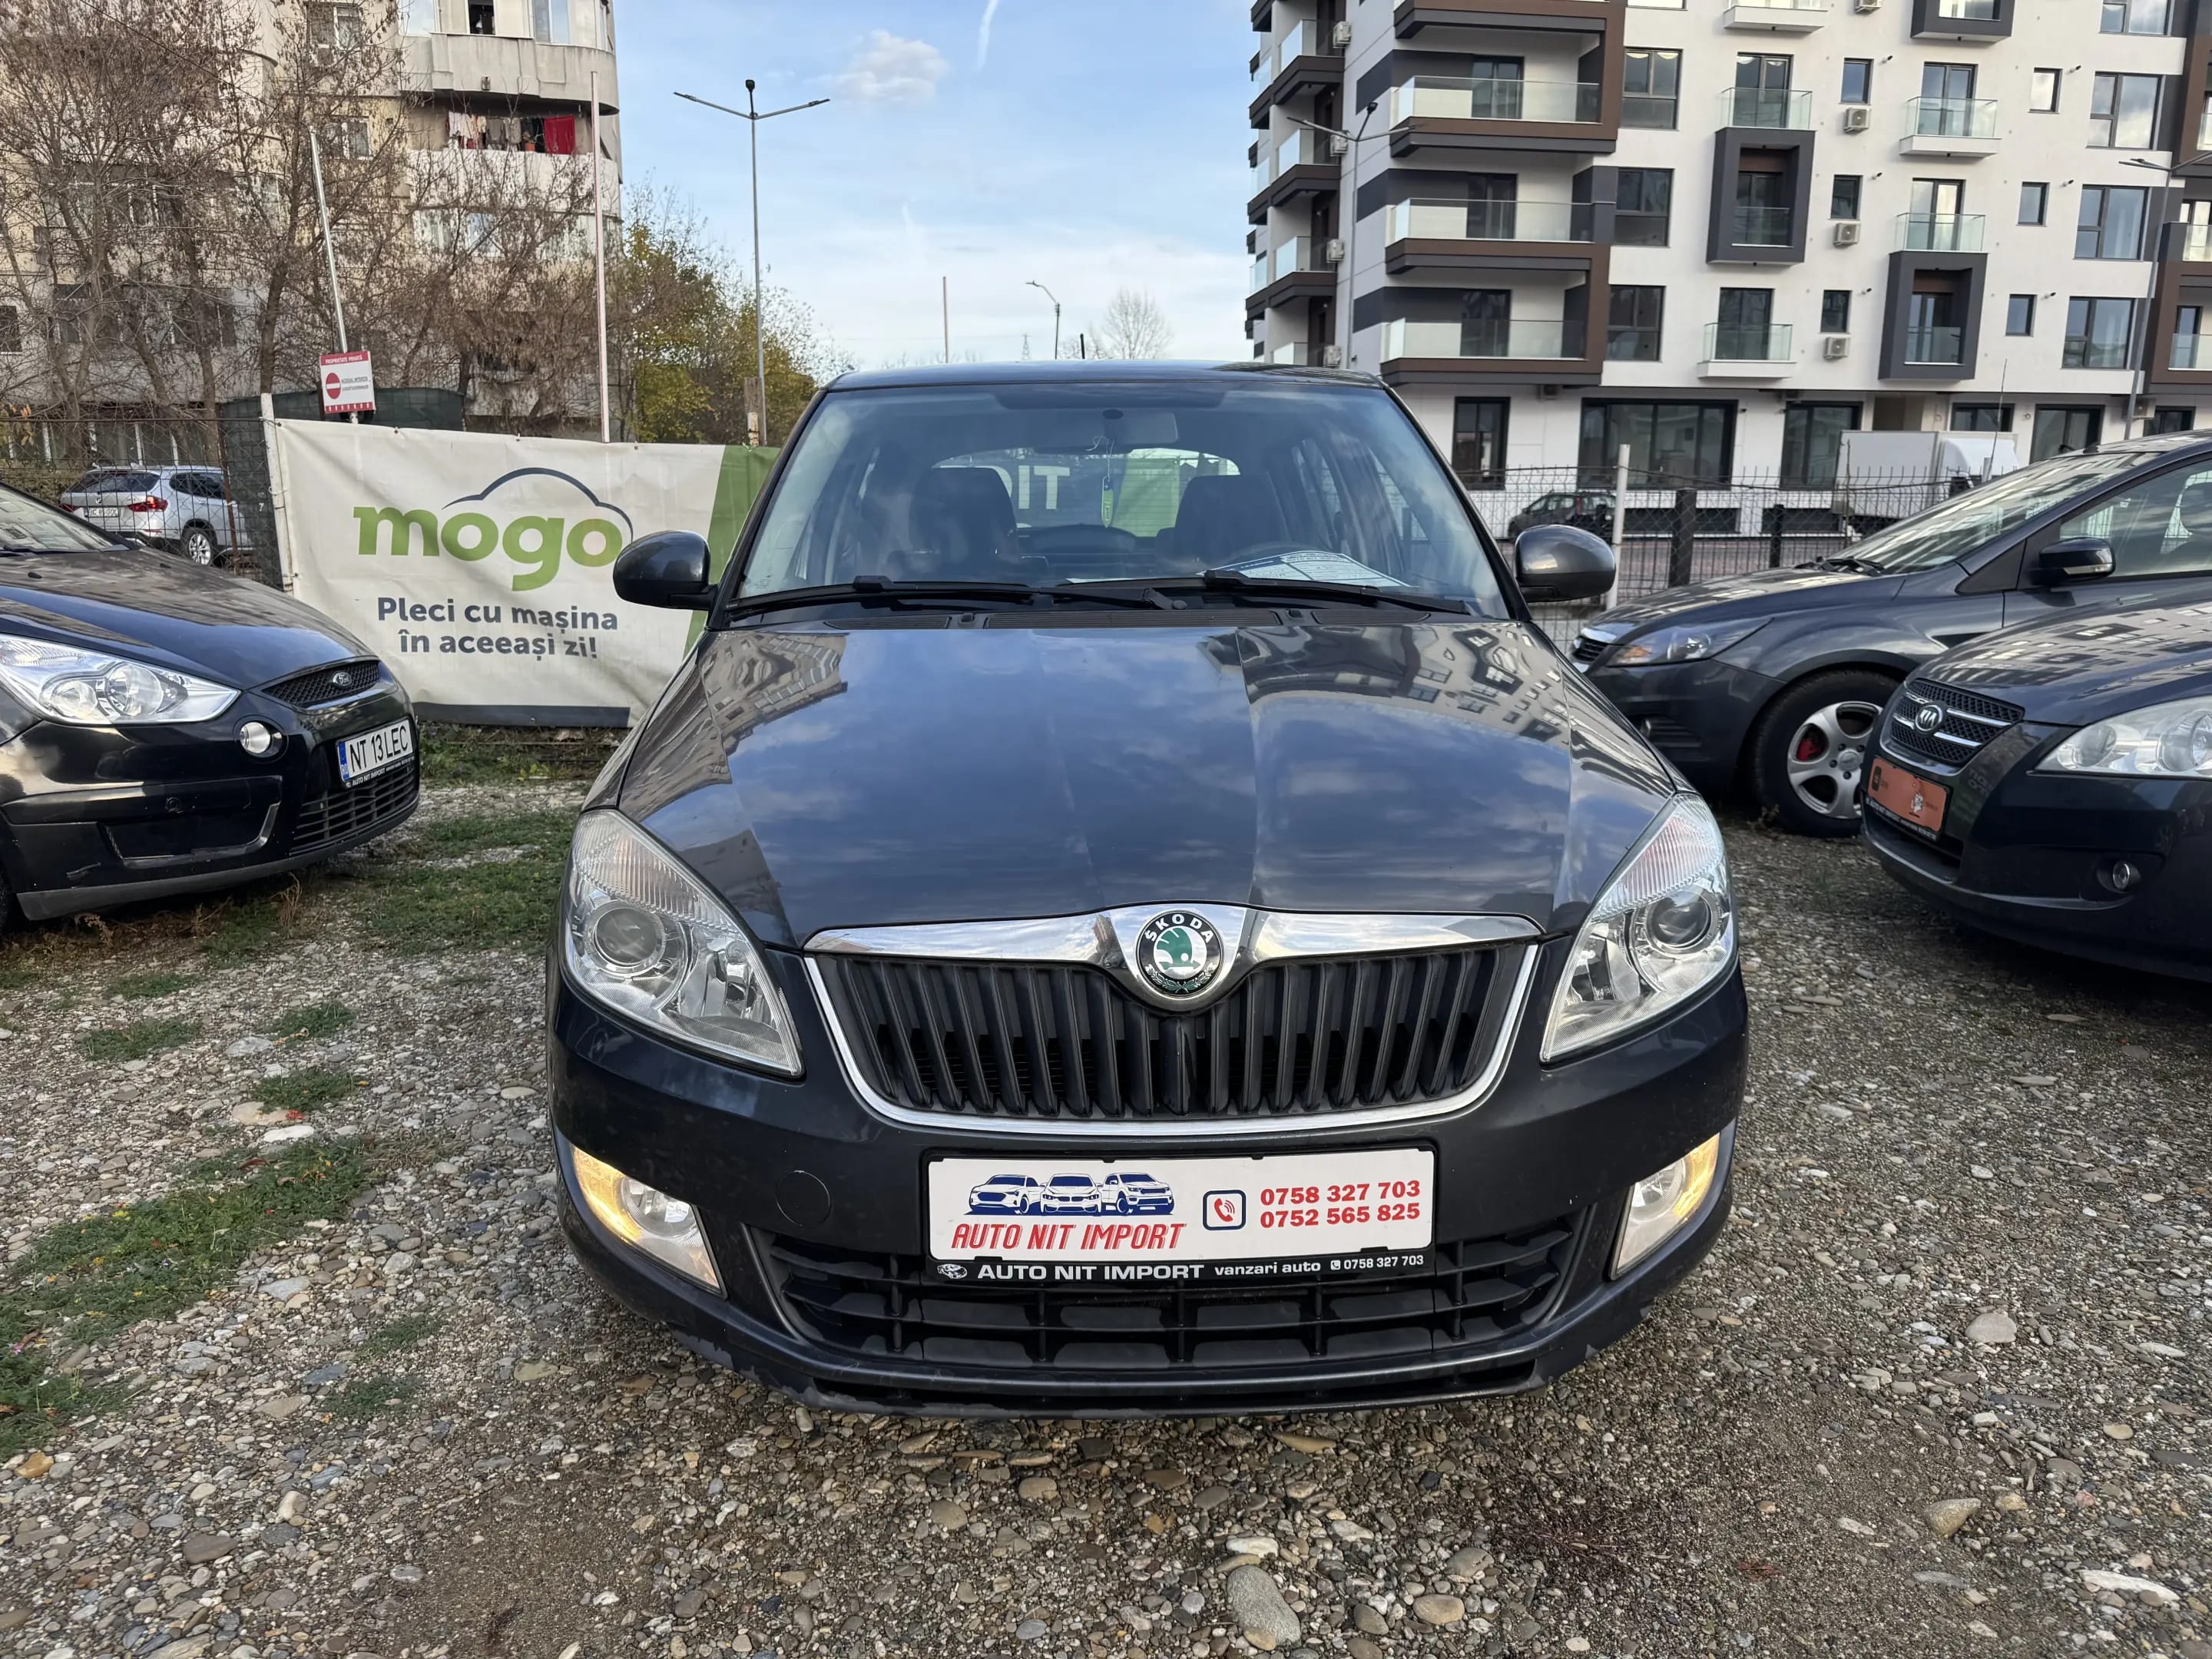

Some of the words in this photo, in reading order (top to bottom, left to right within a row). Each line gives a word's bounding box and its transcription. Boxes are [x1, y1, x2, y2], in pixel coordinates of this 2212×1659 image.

[353, 506, 623, 591] mogo
[377, 597, 455, 623] Pleci
[464, 604, 502, 624] cu
[512, 605, 618, 634] mașina
[398, 629, 430, 653] în
[439, 632, 555, 661] aceeași
[563, 636, 598, 659] zi!
[349, 739, 367, 773] NT
[371, 733, 384, 763] 13
[384, 725, 409, 758] LEC
[1260, 1186, 1320, 1206] 0758
[1326, 1184, 1370, 1203] 327
[1377, 1180, 1421, 1199] 703
[1260, 1209, 1320, 1229] 0752
[1326, 1206, 1370, 1225] 565
[1376, 1203, 1420, 1222] 825
[951, 1223, 1024, 1250] AUTO
[1027, 1224, 1077, 1250] NIT
[1081, 1223, 1187, 1250] IMPORT
[977, 1264, 1047, 1280] AUTO
[1055, 1265, 1097, 1280] NIT
[1104, 1264, 1205, 1280] IMPORT
[1214, 1261, 1277, 1276] vanzari
[1282, 1262, 1321, 1273] auto
[1343, 1258, 1374, 1270] 0758
[1376, 1257, 1399, 1268] 327
[1402, 1255, 1424, 1266] 703
